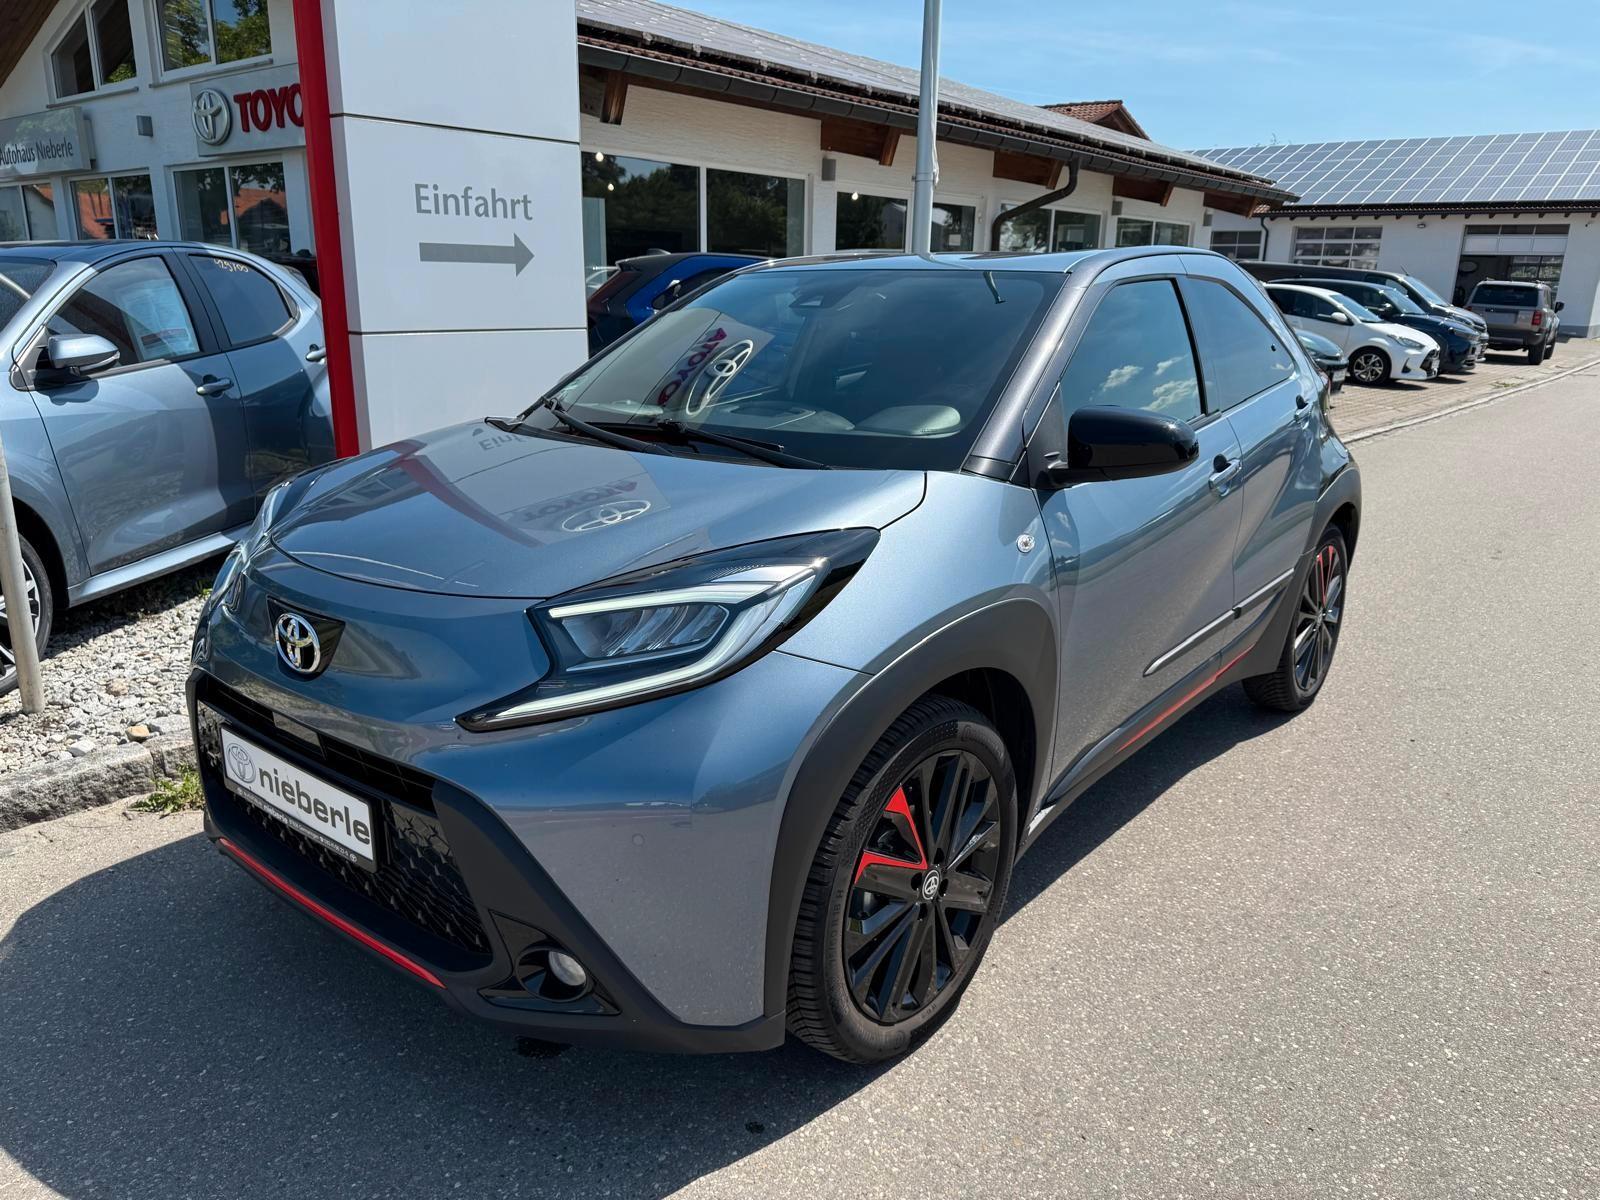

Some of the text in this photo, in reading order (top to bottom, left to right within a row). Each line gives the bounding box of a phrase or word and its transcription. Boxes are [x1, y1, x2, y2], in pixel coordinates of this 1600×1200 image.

[233, 83, 305, 133] TOYO
[0, 136, 74, 166] Autohaus Nieberle
[414, 183, 533, 221] Einfahrt
[258, 767, 370, 846] nieberle
